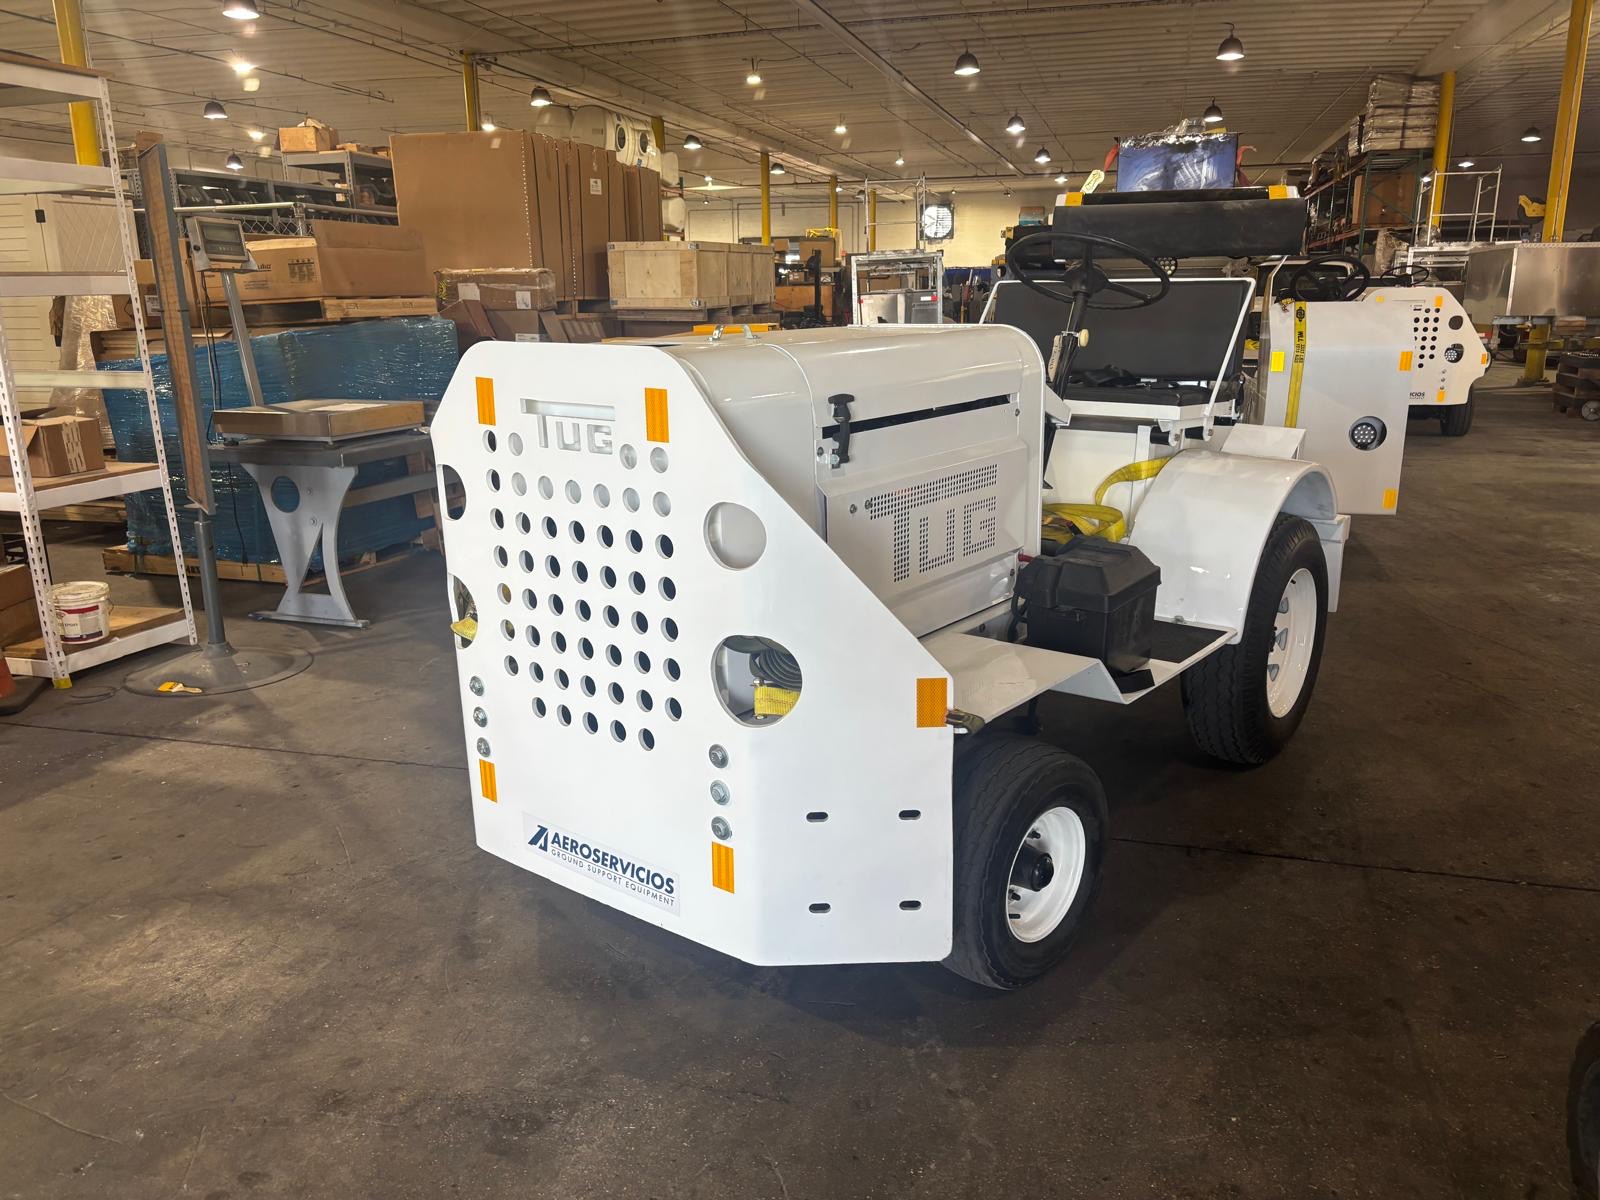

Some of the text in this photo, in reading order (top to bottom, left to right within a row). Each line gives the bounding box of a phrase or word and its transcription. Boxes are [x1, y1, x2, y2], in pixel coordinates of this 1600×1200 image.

[520, 398, 616, 455] TUG
[870, 464, 998, 582] TUG
[551, 832, 675, 895] AEROSERVICIOS
[551, 849, 675, 907] GROUND SUPPORT EQUIPMENT
